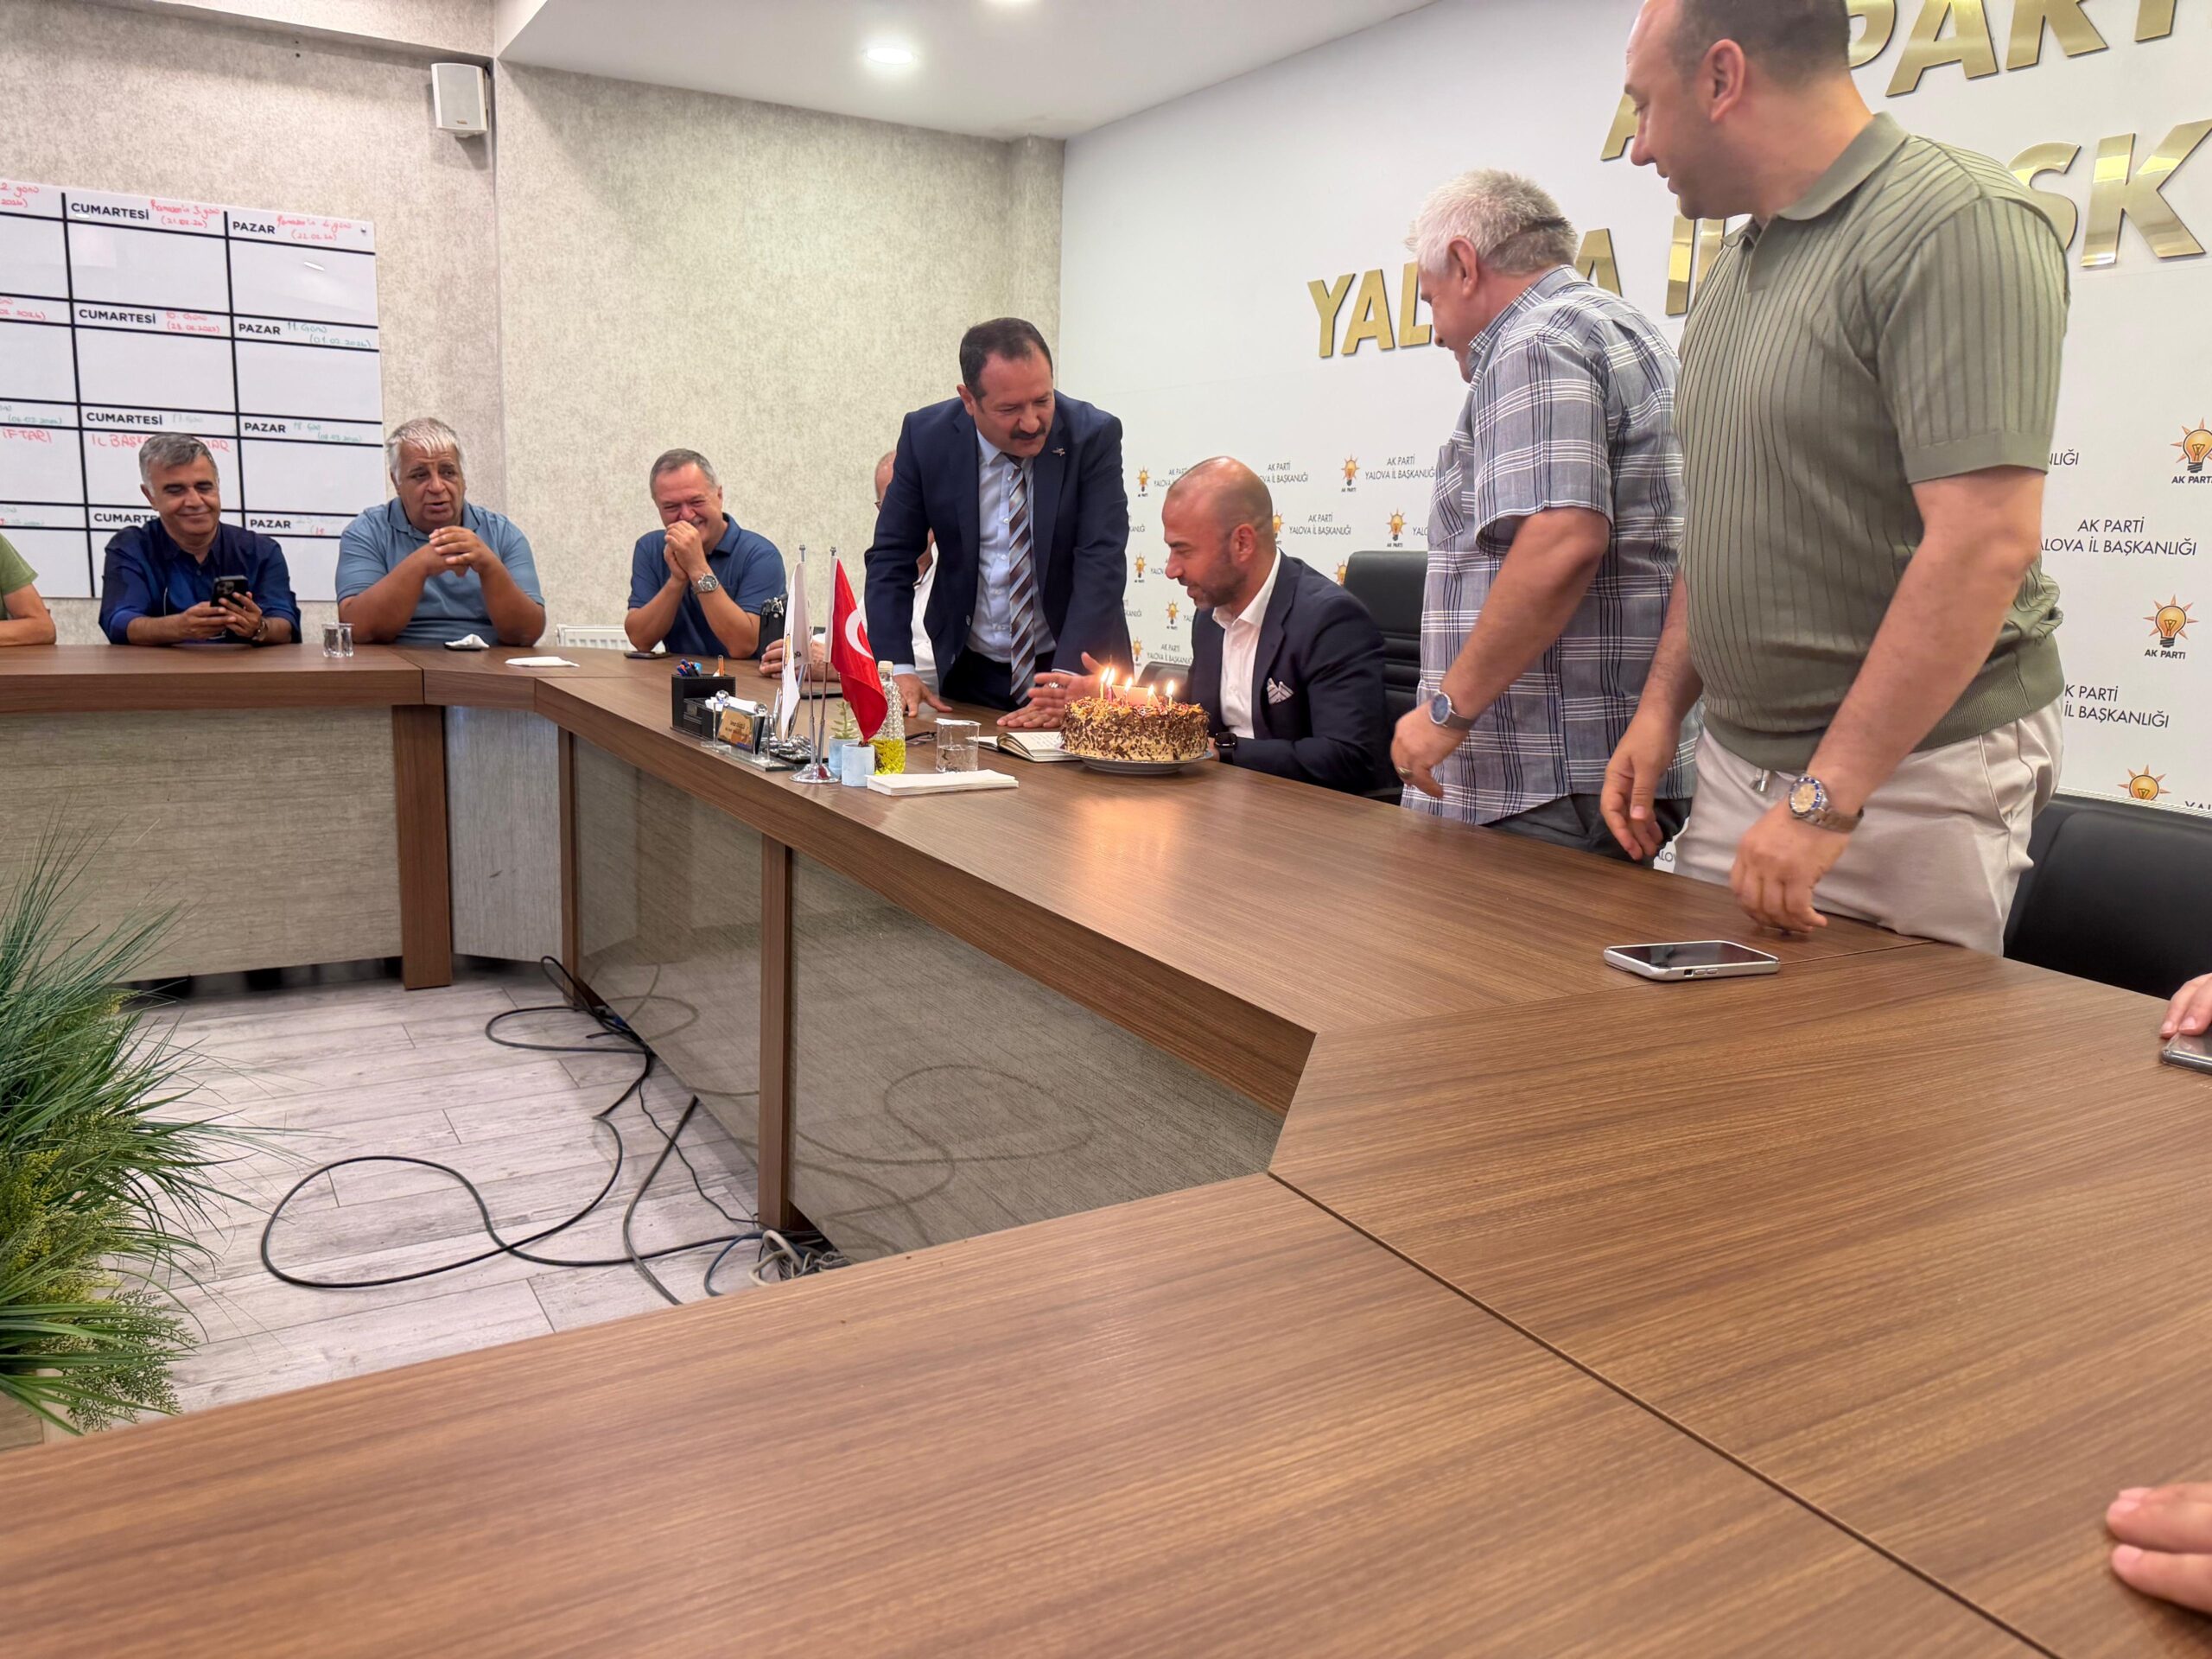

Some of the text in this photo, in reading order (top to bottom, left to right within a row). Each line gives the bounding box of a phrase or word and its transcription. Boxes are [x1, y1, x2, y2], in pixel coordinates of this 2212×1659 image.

[71, 202, 149, 220] CUMARTESİ
[232, 221, 276, 234] PAZAR
[79, 309, 156, 324] CUMARTESİ
[238, 323, 281, 335] PAZAR
[86, 412, 163, 425] CUMARTESİ
[245, 423, 286, 433] PAZAR
[1387, 454, 1415, 466] AK PARTİ
[1365, 470, 1390, 480] YALOVA
[1398, 467, 1435, 480] BAŞKANLIĞ
[1318, 512, 1333, 522] PARTİ
[251, 519, 291, 529] PAZAR
[1289, 525, 1312, 535] YALOVA
[2077, 517, 2145, 533] AK PARTİ
[2040, 536, 2196, 556] LOVA İL BAŞKANLIĞI
[2145, 649, 2158, 658] AK
[2064, 684, 2119, 702] K PARTİ
[2064, 701, 2170, 728] İL BAŞKANLIĞI
